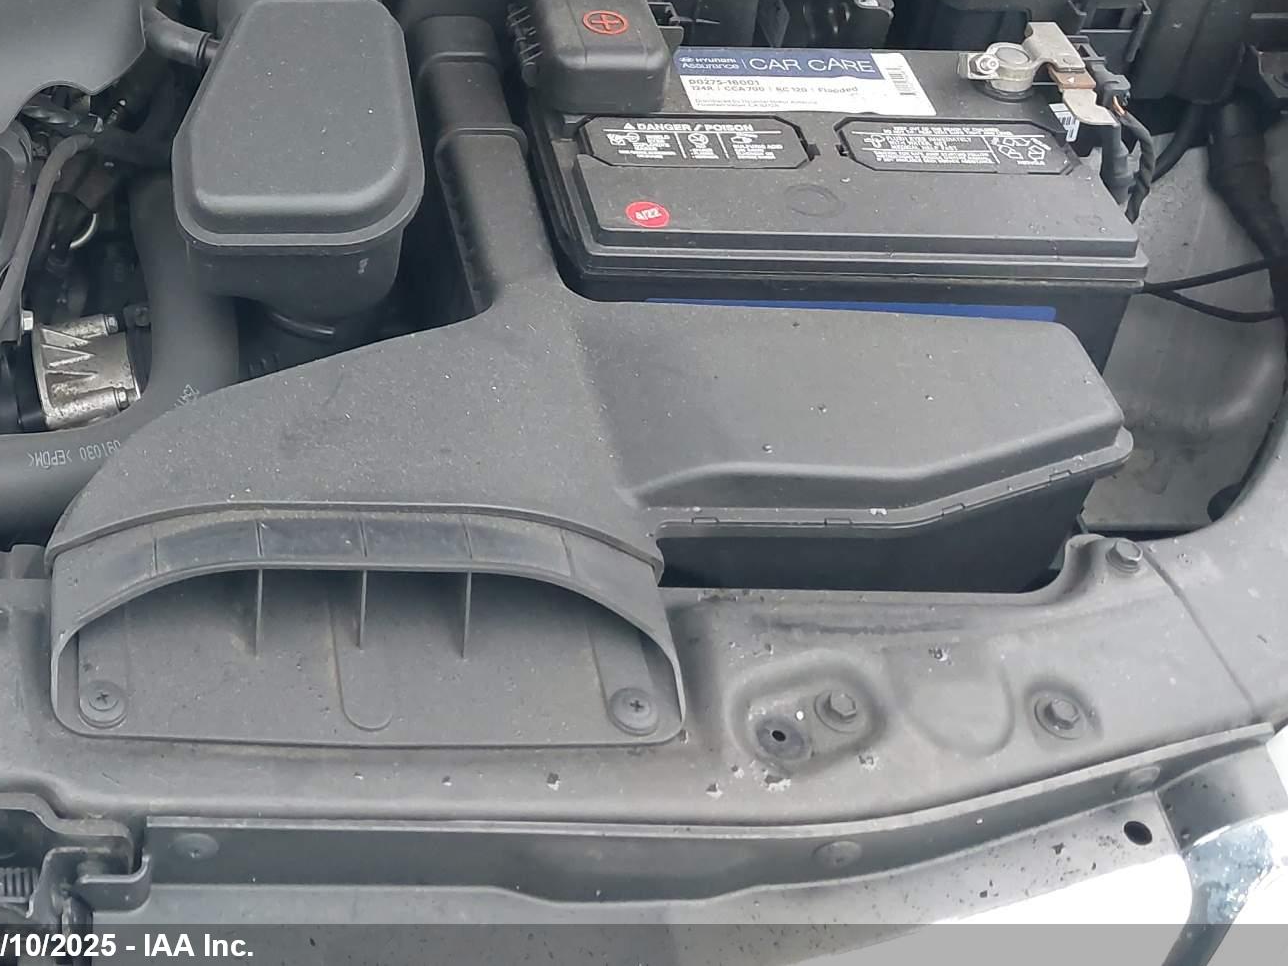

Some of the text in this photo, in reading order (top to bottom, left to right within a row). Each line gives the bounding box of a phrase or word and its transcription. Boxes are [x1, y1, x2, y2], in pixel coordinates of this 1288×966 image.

[750, 56, 876, 73] CAR CARE
[636, 123, 692, 131] DANGER
[704, 124, 754, 132] POISON
